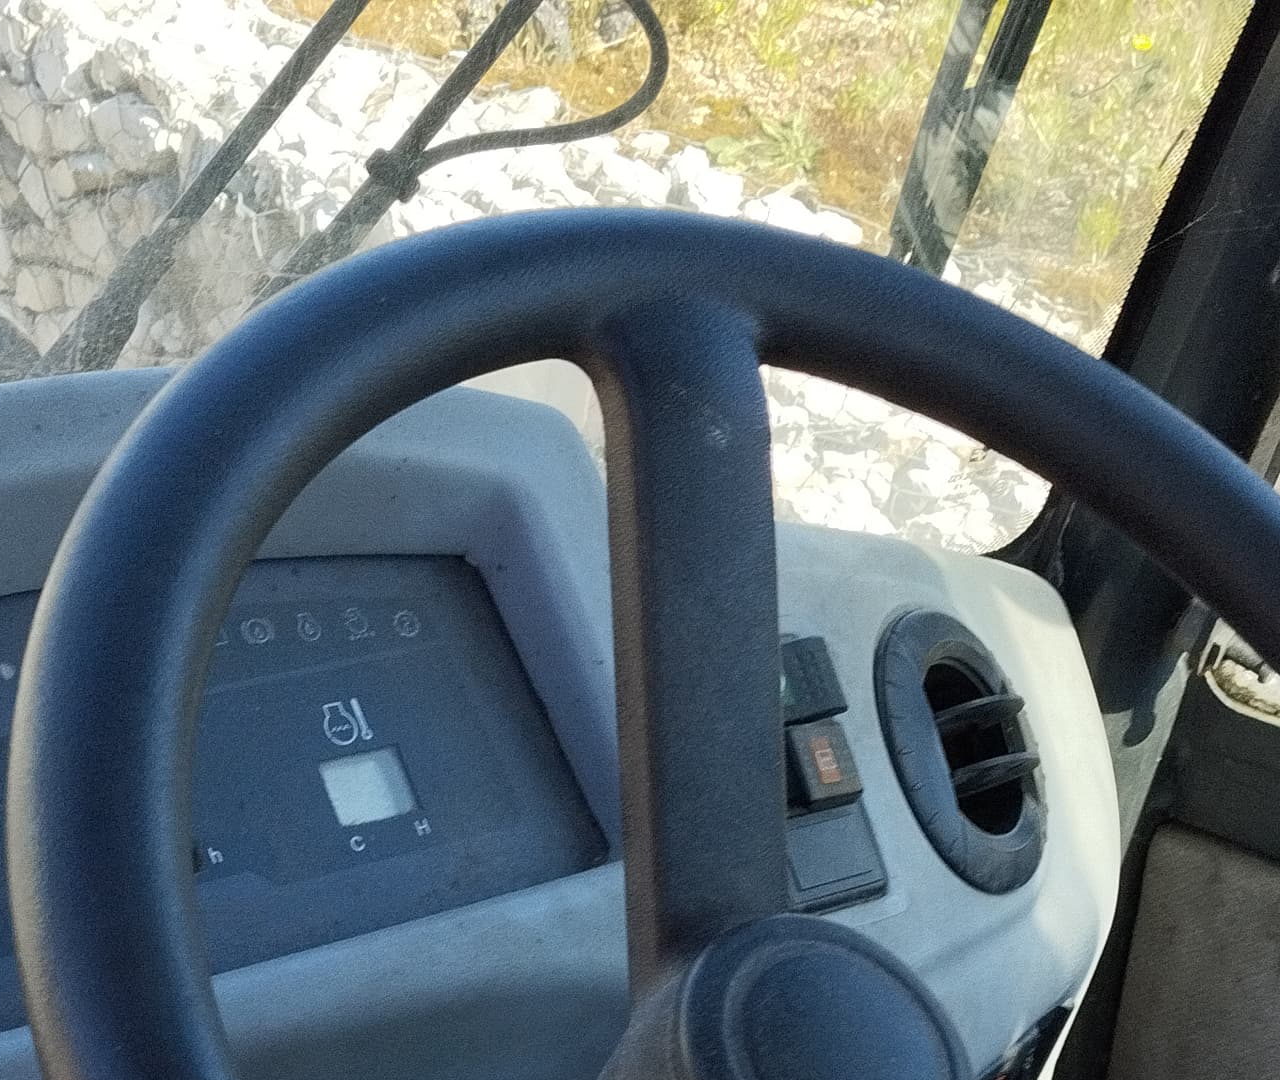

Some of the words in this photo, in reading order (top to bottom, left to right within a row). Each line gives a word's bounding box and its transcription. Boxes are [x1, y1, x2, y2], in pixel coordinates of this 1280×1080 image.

[350, 835, 366, 852] C
[414, 817, 432, 836] H
[207, 847, 224, 864] h
